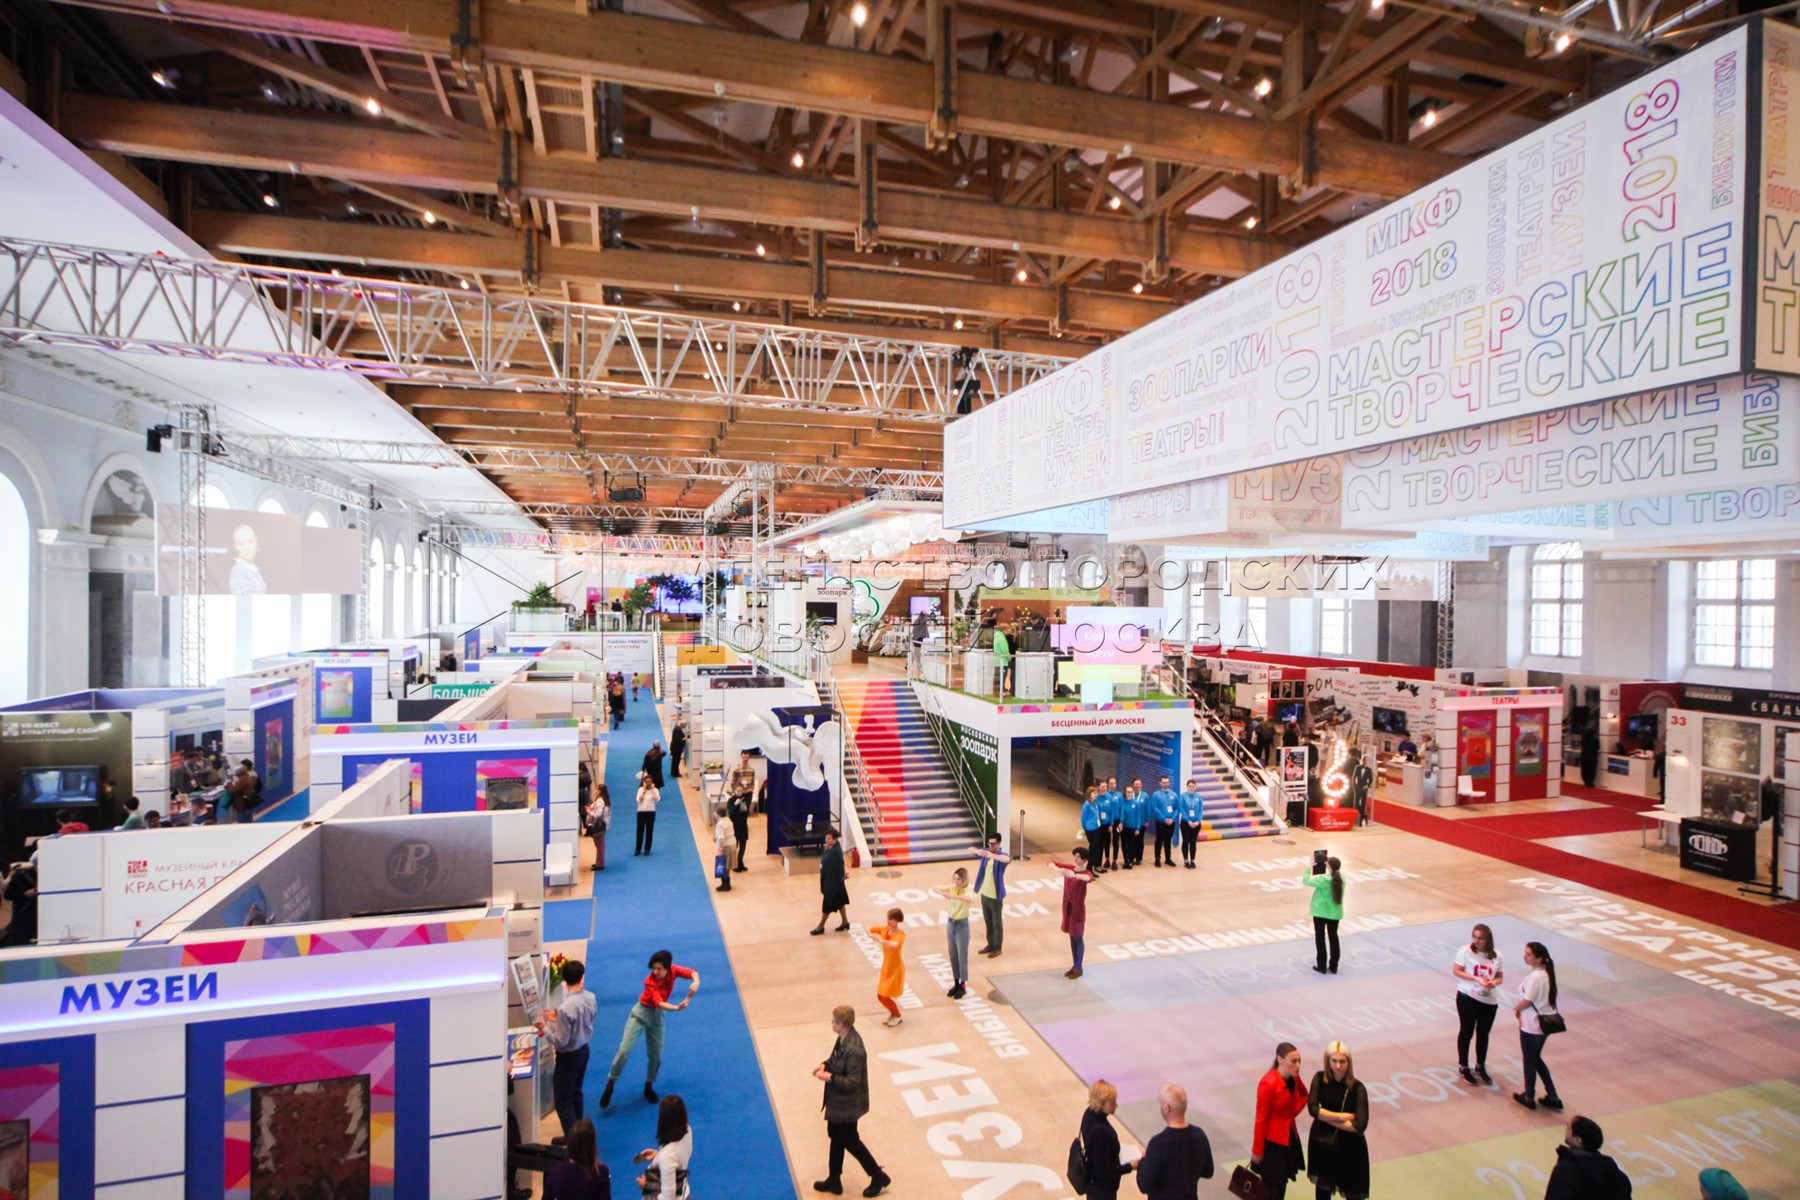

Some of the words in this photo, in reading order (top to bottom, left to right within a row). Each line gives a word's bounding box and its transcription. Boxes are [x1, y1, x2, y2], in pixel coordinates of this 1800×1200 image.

[1622, 78, 1680, 243] 2018
[1711, 51, 1737, 210] БИБЛИОТЕКИ
[1366, 186, 1461, 258] МКФ
[1486, 158, 1508, 295] ЗООПАРКИ
[1517, 140, 1545, 286] ТЕАТРЫ
[1550, 120, 1586, 274] МУЗЕИ
[1370, 240, 1457, 306] 2018
[1328, 221, 1732, 396] МАСТЕРСКИЕ
[1129, 326, 1272, 412] ЗООПАРКИ
[1274, 252, 1322, 450] 2018
[1328, 292, 1730, 441] ТВОРЧЕСКИЕ
[1018, 365, 1093, 440] МКФ
[1045, 408, 1111, 456] ТЕАТРЫ
[1044, 440, 1110, 489] МУЗЕИ
[1129, 413, 1216, 465] ТЕАТРЫ
[1402, 424, 1718, 507] ТВОРЧЕСКИЕ
[1051, 718, 1097, 728] БЕСЦЕННЫЙ
[1098, 718, 1115, 728] ДАР
[1115, 717, 1146, 726] МОСКВЕ
[1491, 697, 1520, 705] ТЕАТРЫ
[1671, 716, 1687, 726] 33
[424, 733, 478, 746] МУЗЕИ
[960, 735, 998, 765] зоопарк
[961, 725, 998, 746] МОСКОВСКИЙ
[125, 877, 206, 894] КРАСНАЯ
[154, 861, 218, 873] МУЗЕЙНЫЙ
[59, 971, 219, 1015] МУЗЕИ
